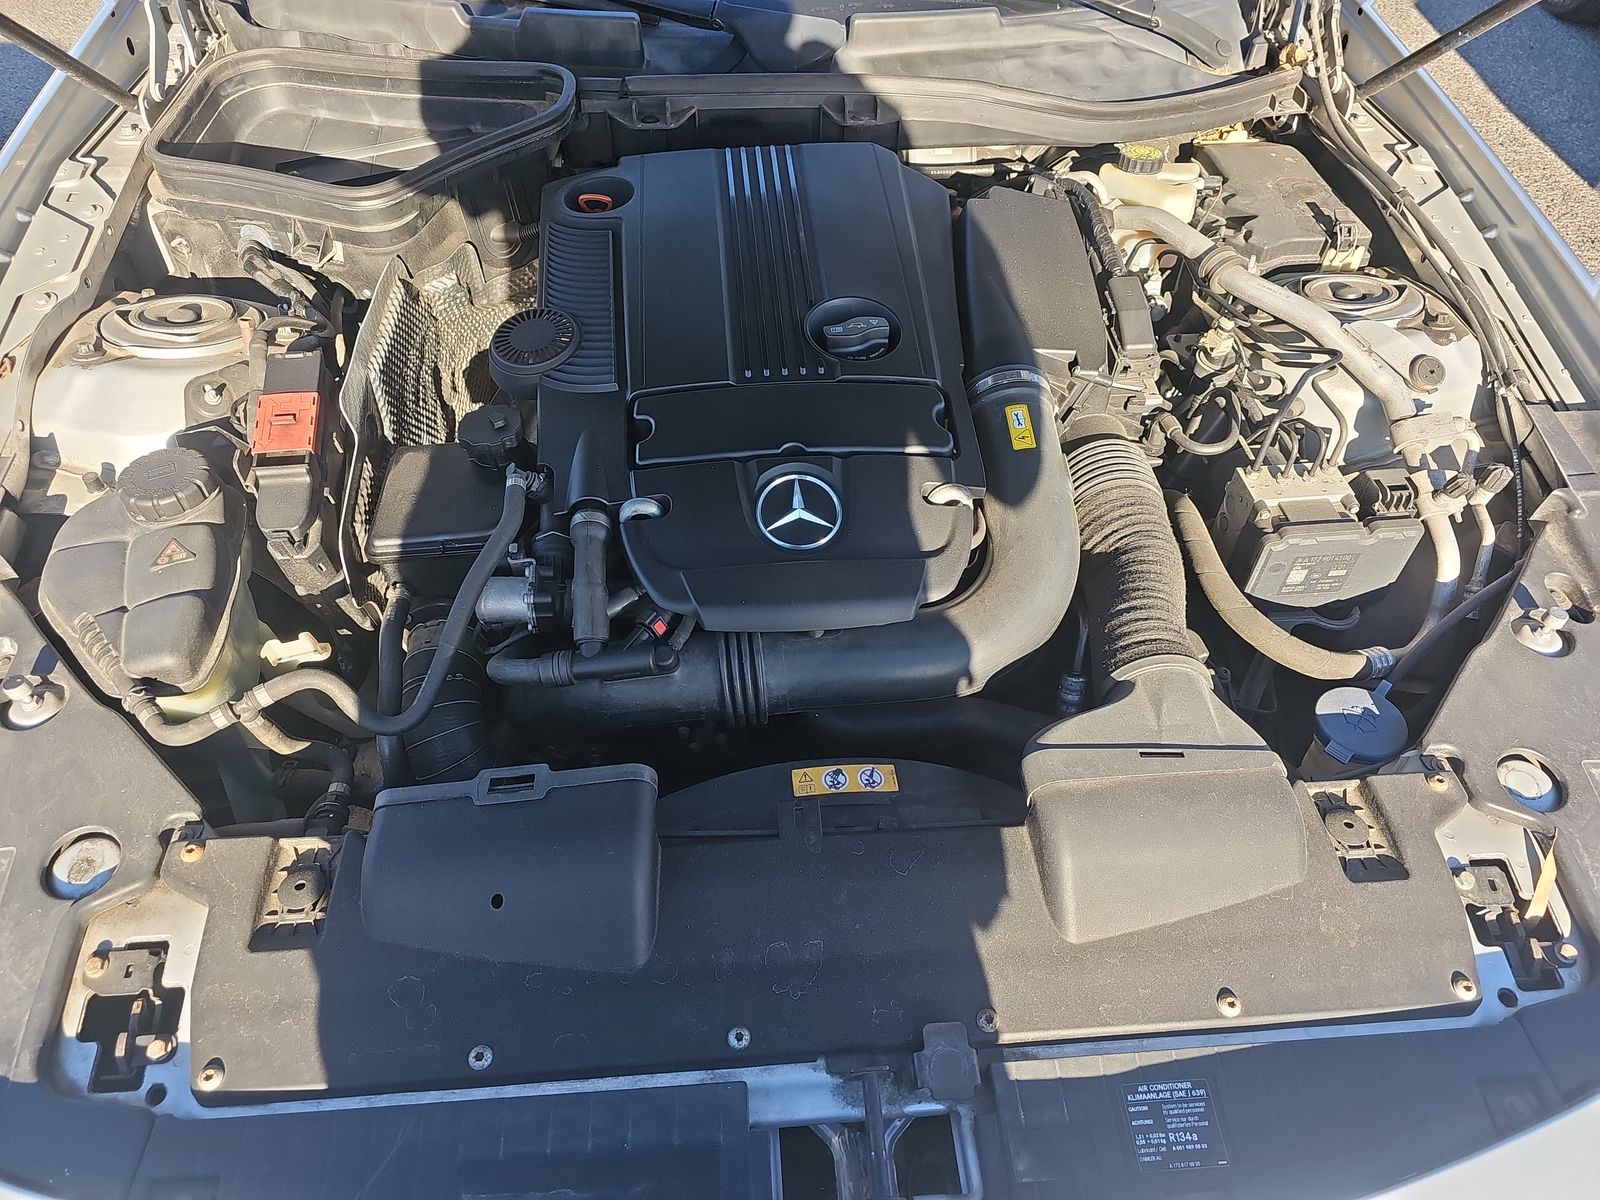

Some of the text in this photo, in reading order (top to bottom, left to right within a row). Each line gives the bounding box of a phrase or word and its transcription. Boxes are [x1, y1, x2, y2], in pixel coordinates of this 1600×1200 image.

[1138, 1081, 1192, 1092] AIR CONDITIONER
[1127, 1092, 1172, 1101] KLIMAANLAGE
[1172, 1090, 1186, 1099] (SAE
[1191, 1089, 1207, 1097] 639)
[1168, 1132, 1199, 1143] R134a
